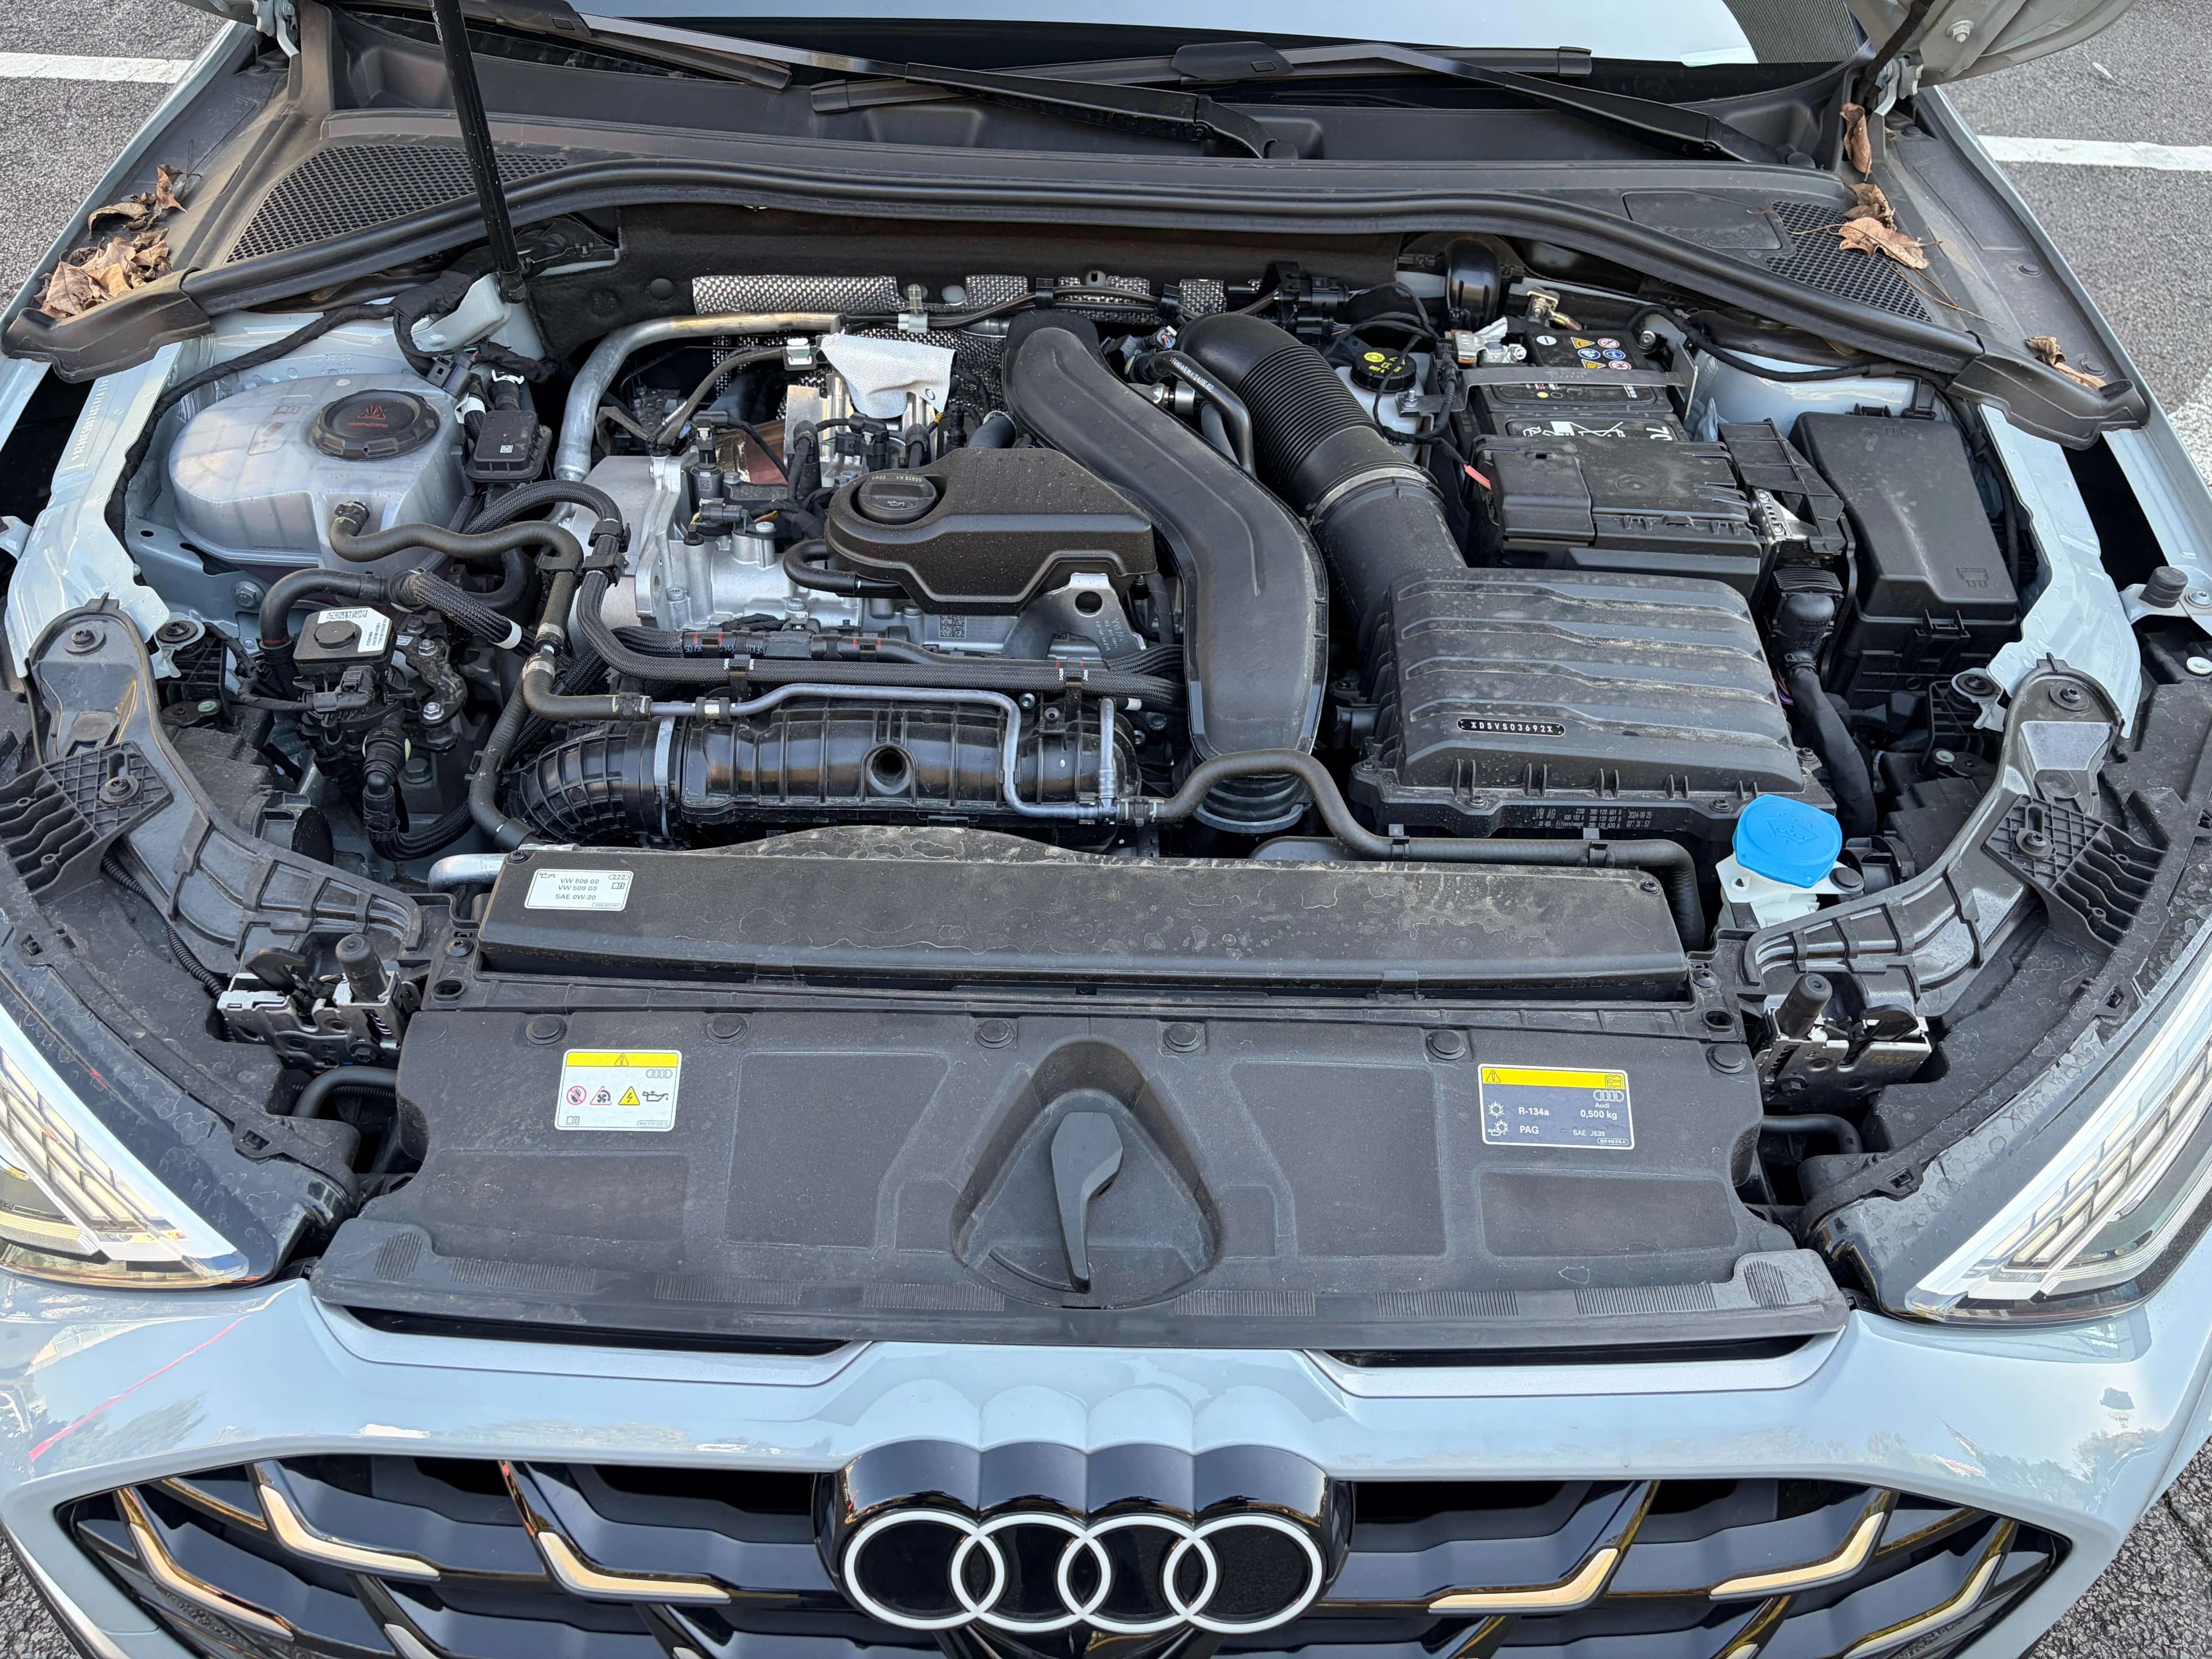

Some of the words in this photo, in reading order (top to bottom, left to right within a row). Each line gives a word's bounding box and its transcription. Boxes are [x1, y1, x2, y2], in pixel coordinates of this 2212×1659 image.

[1479, 721, 1546, 733] DSVS03692
[1518, 1107, 1550, 1116] R-134a
[1580, 1109, 1604, 1119] 0,500
[1607, 1110, 1618, 1120] kg
[1520, 1125, 1539, 1134] PAG
